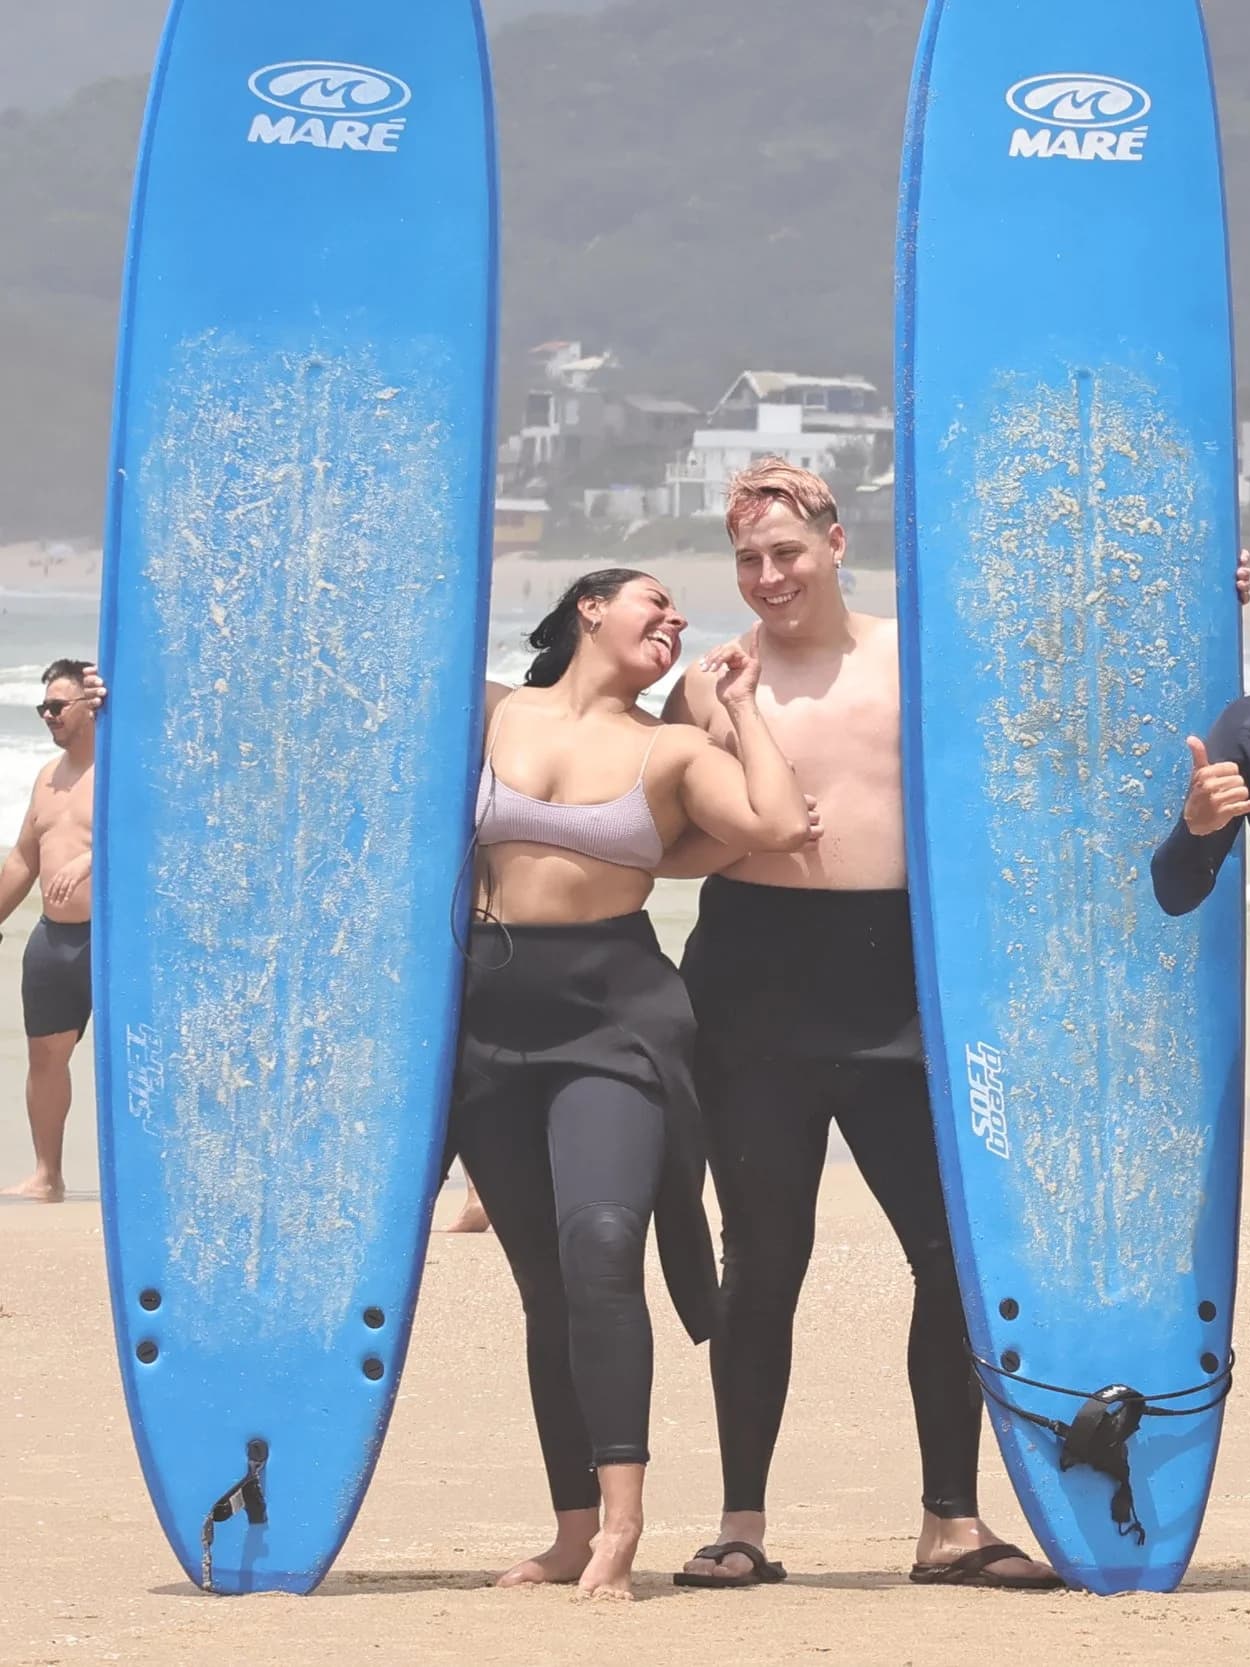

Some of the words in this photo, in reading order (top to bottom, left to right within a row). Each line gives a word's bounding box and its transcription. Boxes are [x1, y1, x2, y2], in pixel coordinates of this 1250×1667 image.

[247, 113, 407, 153] MARÉ
[1008, 125, 1149, 161] MARÉ
[965, 1042, 991, 1137] SOFT
[978, 1040, 1009, 1160] board
